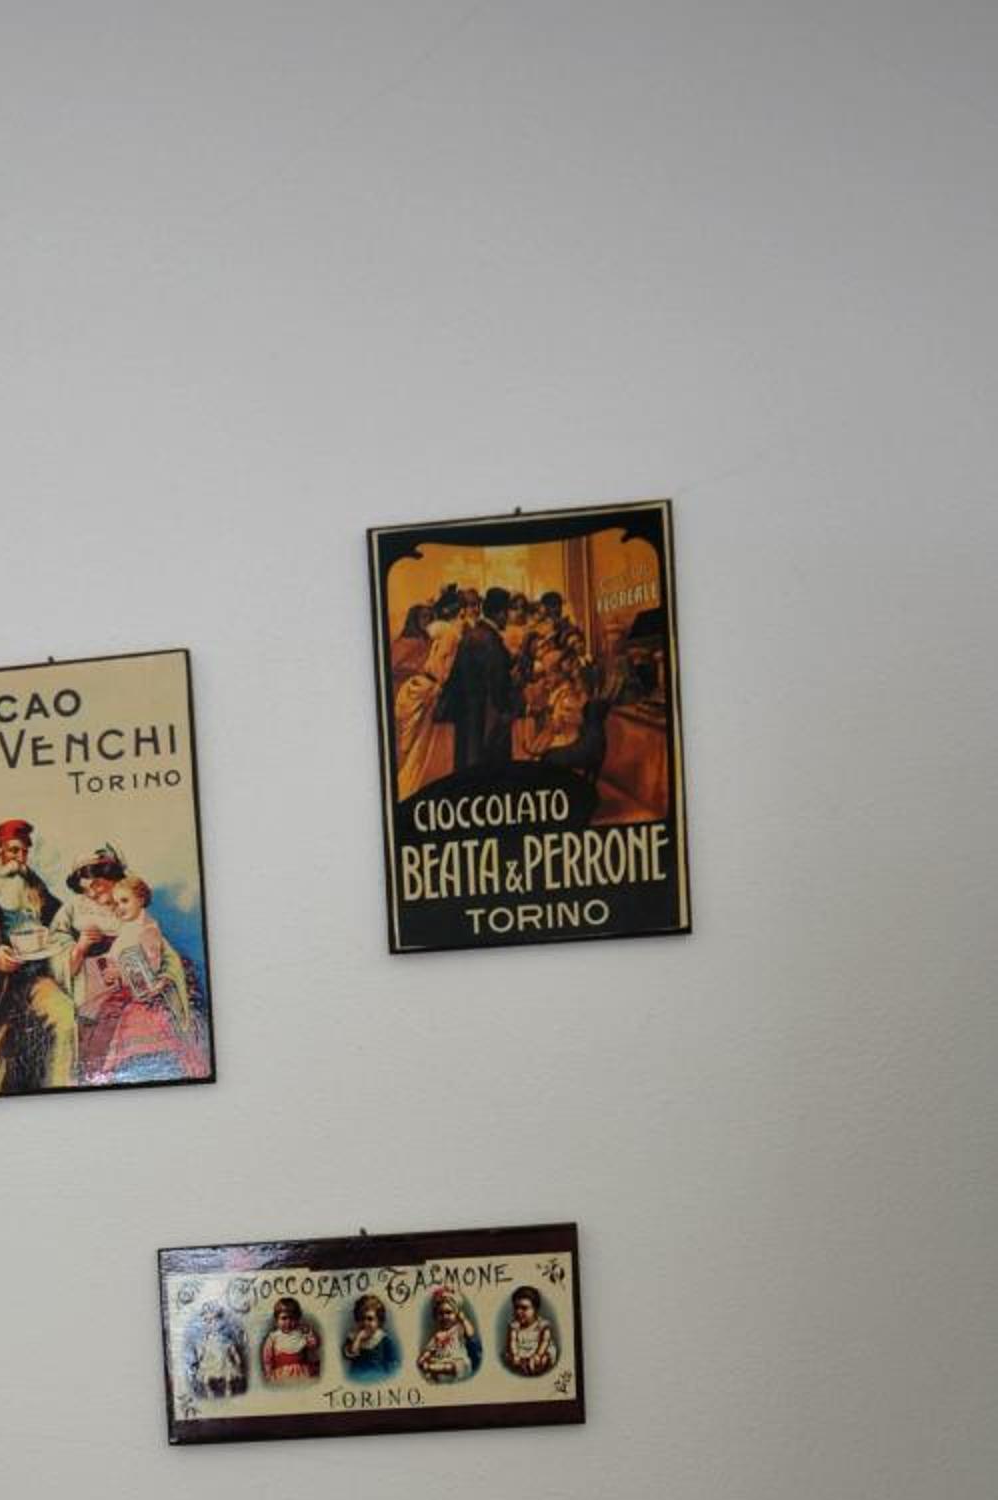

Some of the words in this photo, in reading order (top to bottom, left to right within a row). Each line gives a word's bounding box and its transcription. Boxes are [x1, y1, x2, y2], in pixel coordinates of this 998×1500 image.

[67, 769, 182, 795] TORINO
[413, 788, 570, 832] CIOCCOLATO
[402, 837, 500, 901] BEATA
[523, 824, 670, 892] PERRONE
[465, 898, 610, 935] TORINO
[376, 1263, 513, 1304] TALMONE
